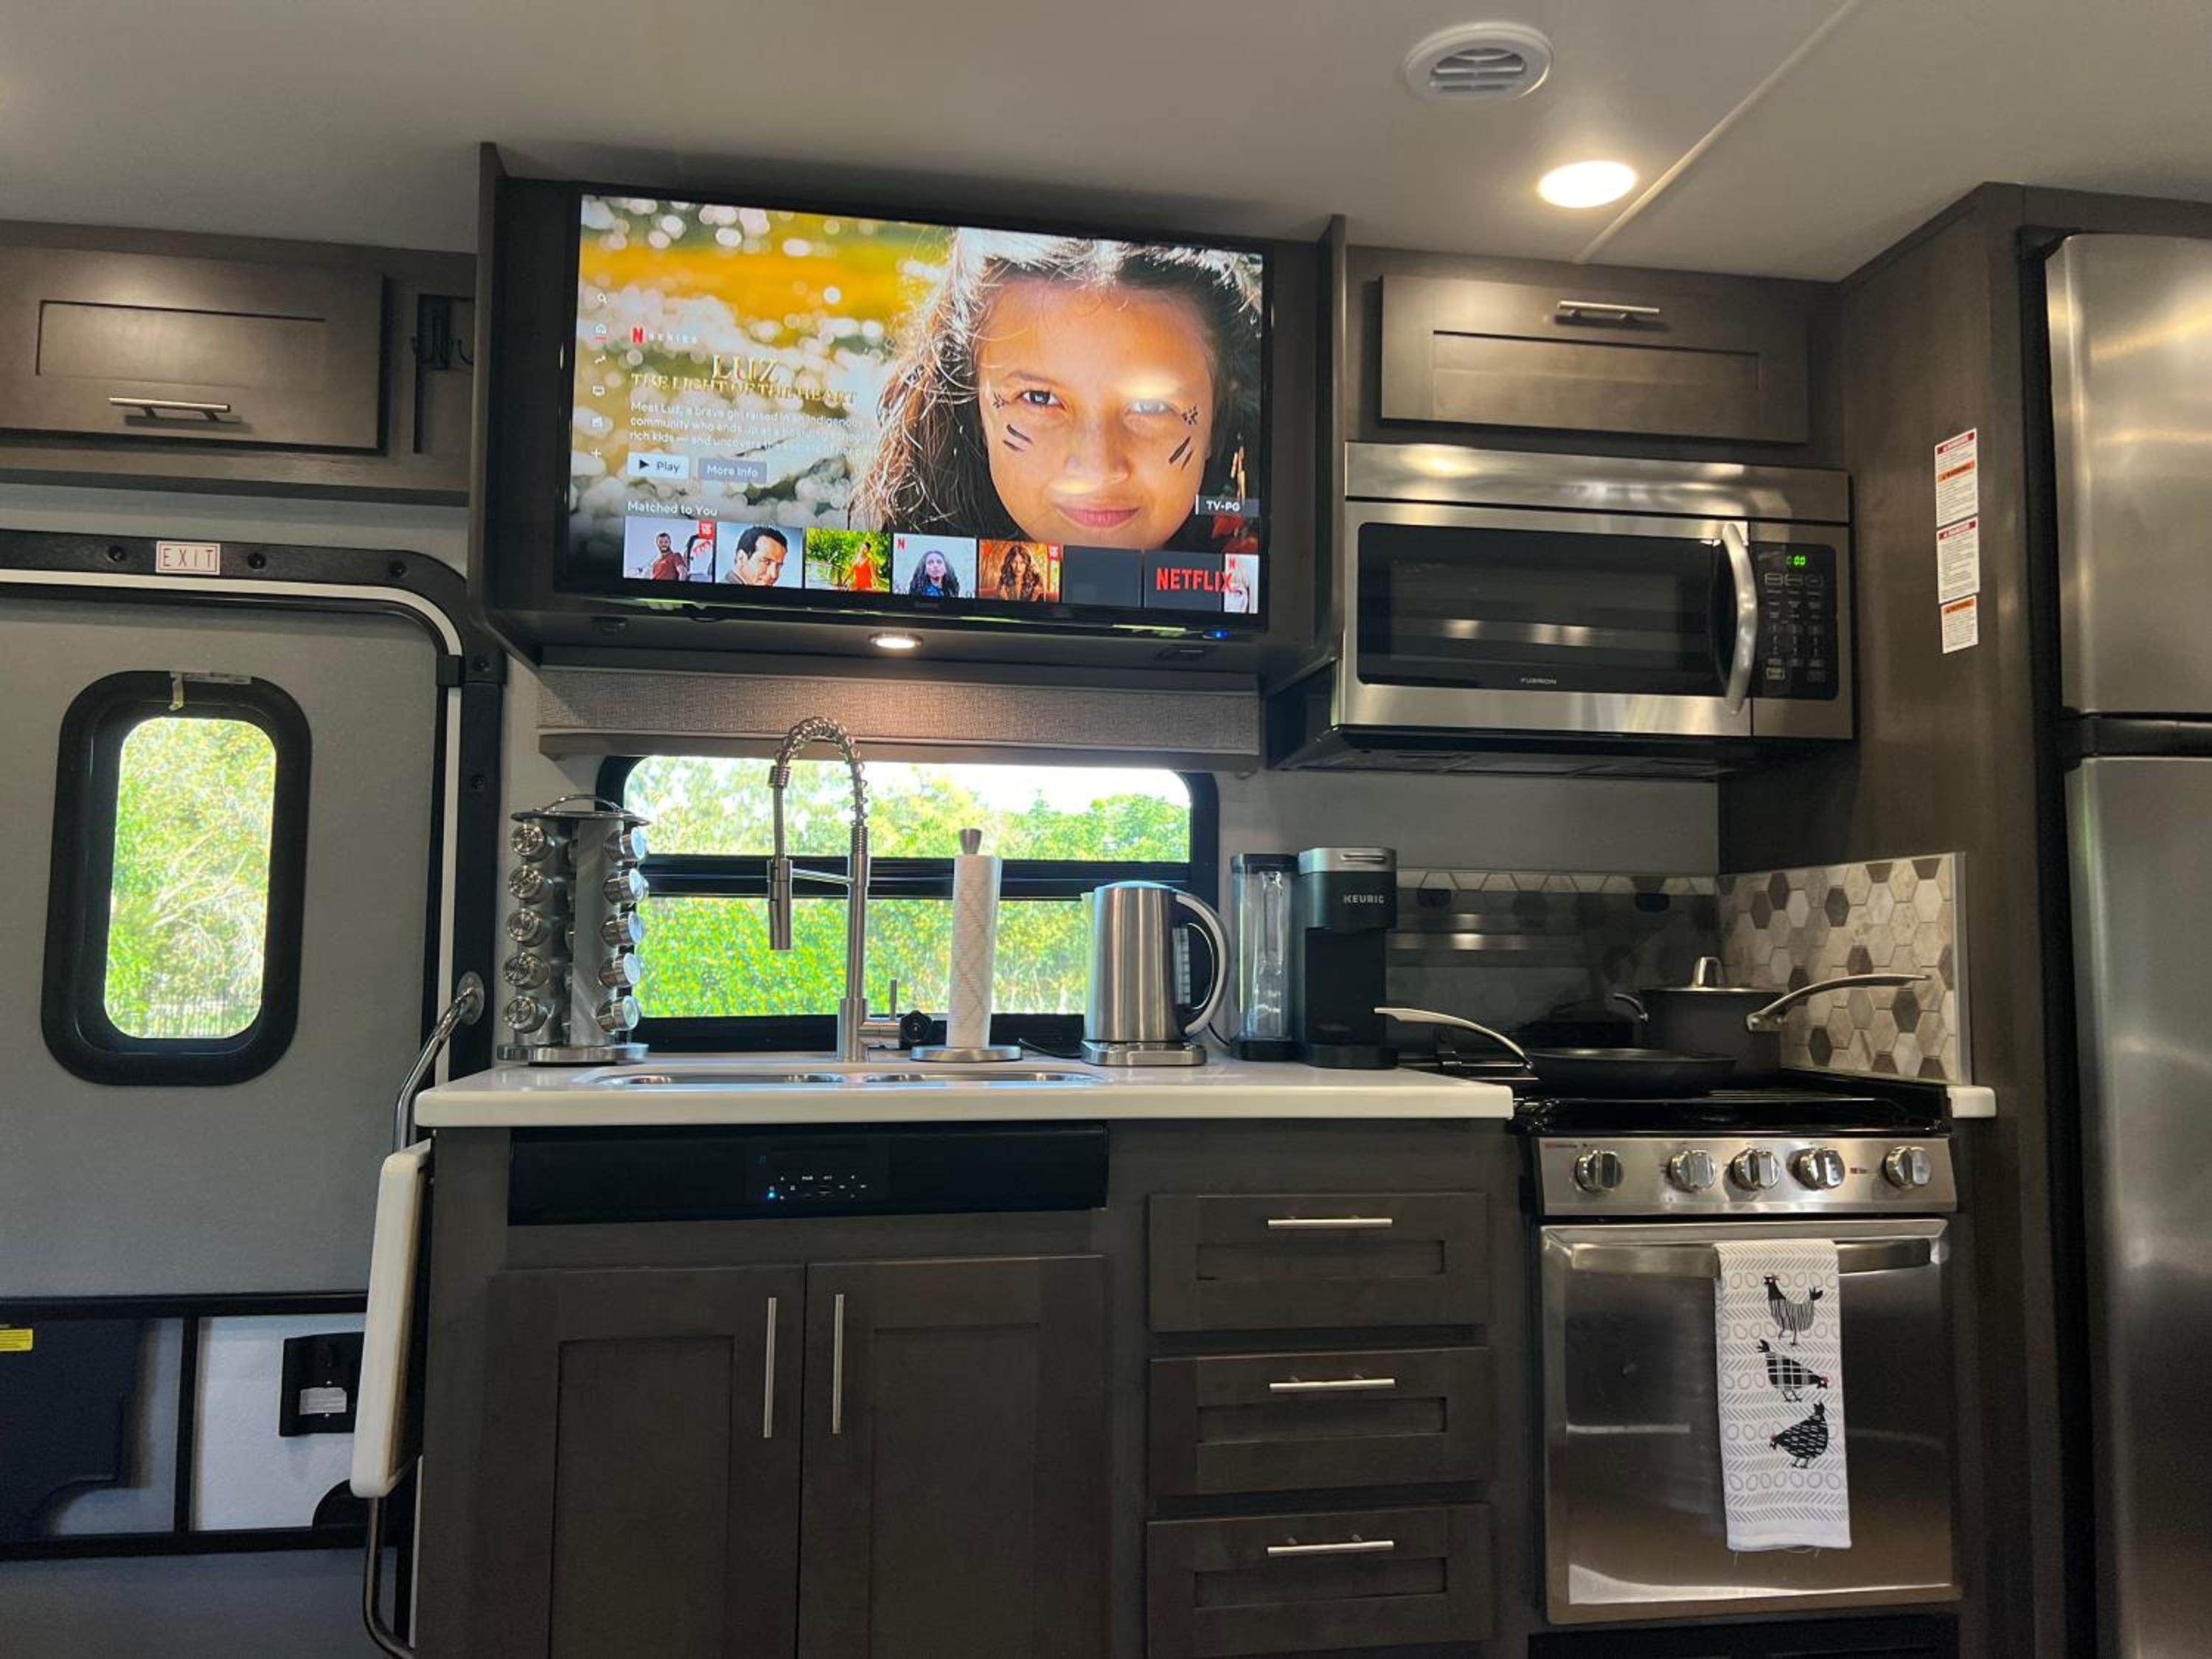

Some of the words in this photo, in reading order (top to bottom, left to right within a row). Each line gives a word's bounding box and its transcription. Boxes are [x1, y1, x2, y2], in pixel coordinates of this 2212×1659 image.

[711, 353, 779, 382] LUZ
[672, 376, 728, 392] LIGHT
[657, 461, 680, 473] Play
[706, 465, 735, 476] More
[737, 467, 758, 478] Info
[627, 501, 678, 514] Matched
[681, 504, 689, 515] to
[695, 507, 717, 517] You
[1206, 500, 1241, 512] TV-PG
[163, 548, 214, 567] EXIT
[1156, 567, 1233, 593] NETFLIX
[1343, 894, 1385, 903] KEURIG
